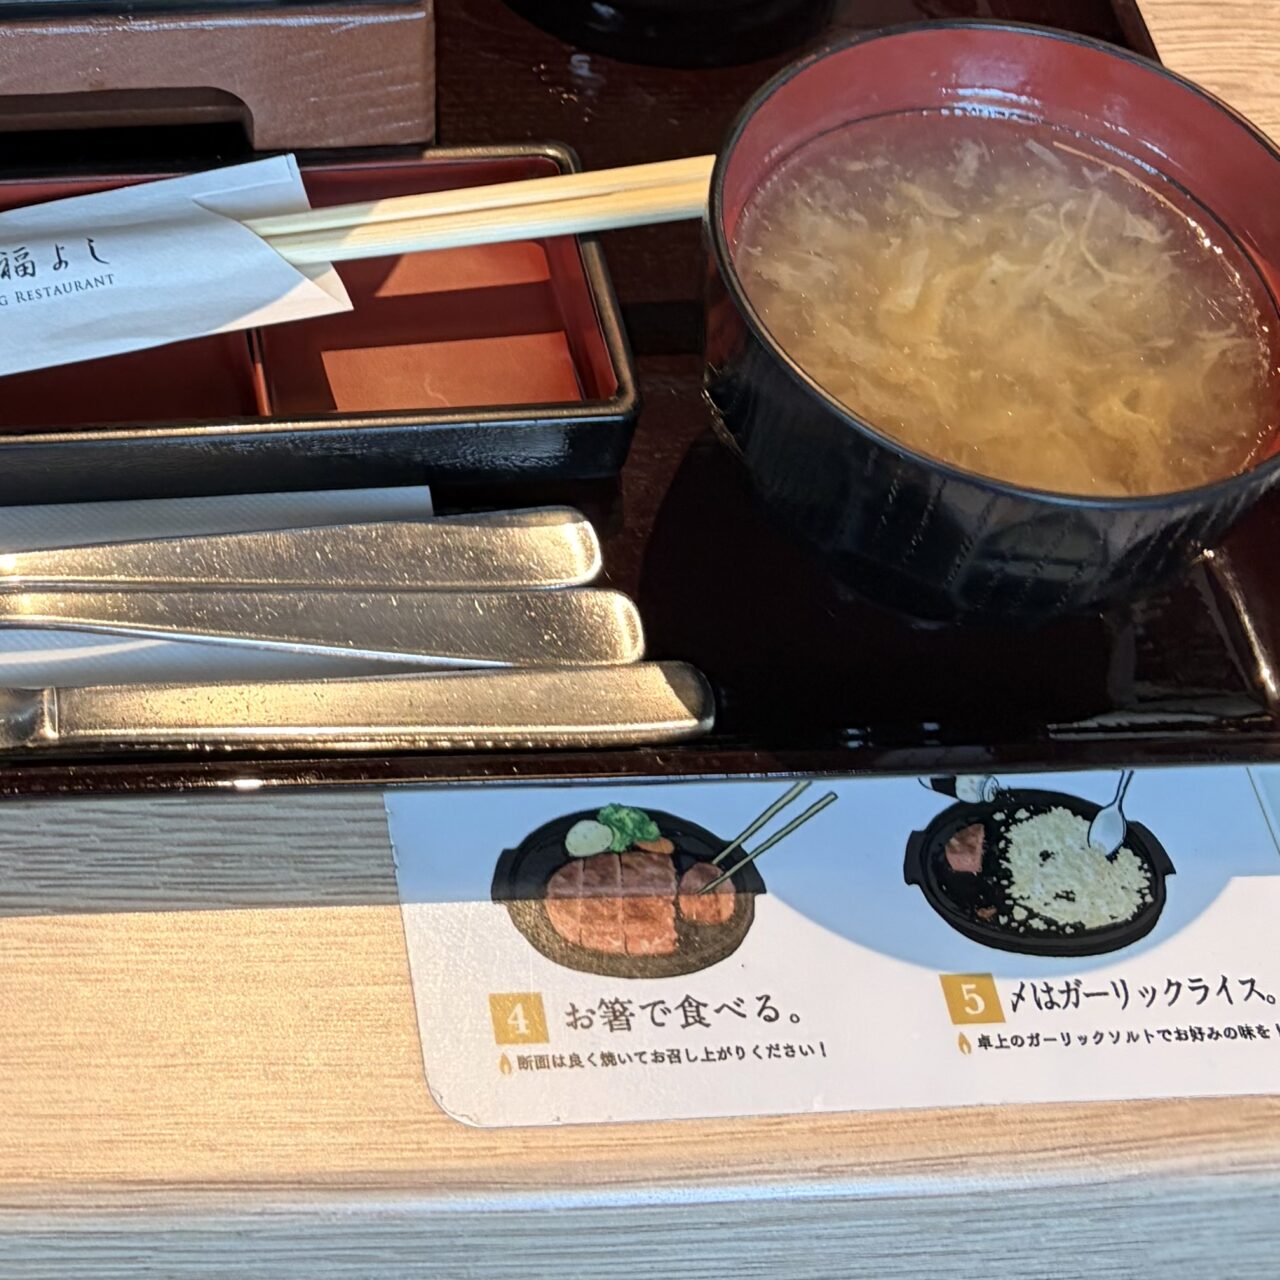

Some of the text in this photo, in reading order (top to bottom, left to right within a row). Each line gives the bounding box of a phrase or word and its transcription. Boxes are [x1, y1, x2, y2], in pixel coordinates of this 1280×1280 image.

[15, 273, 116, 304] RESTAURANT
[507, 993, 802, 1036] 4 お箸で食べる。
[961, 974, 1277, 1015] 5 〆はガーリックライス。
